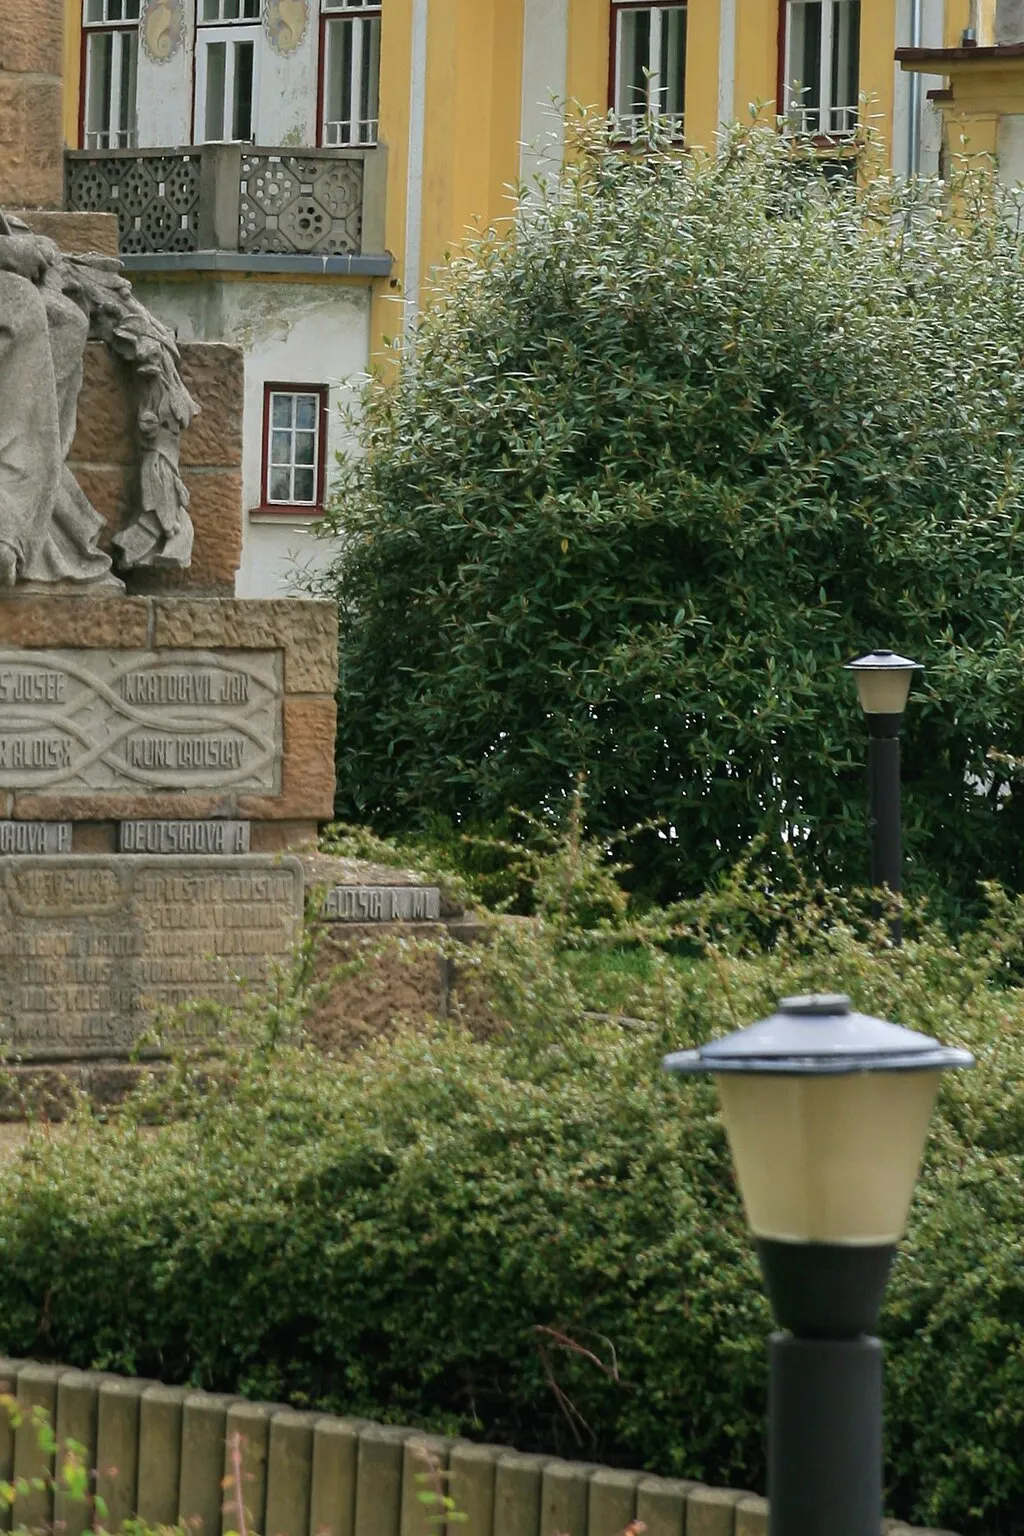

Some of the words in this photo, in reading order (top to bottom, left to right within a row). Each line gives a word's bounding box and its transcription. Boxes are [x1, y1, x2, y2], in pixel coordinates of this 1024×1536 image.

[13, 671, 65, 701] JOSEF
[220, 674, 250, 703] JAN
[321, 889, 383, 921] EUTSCH
